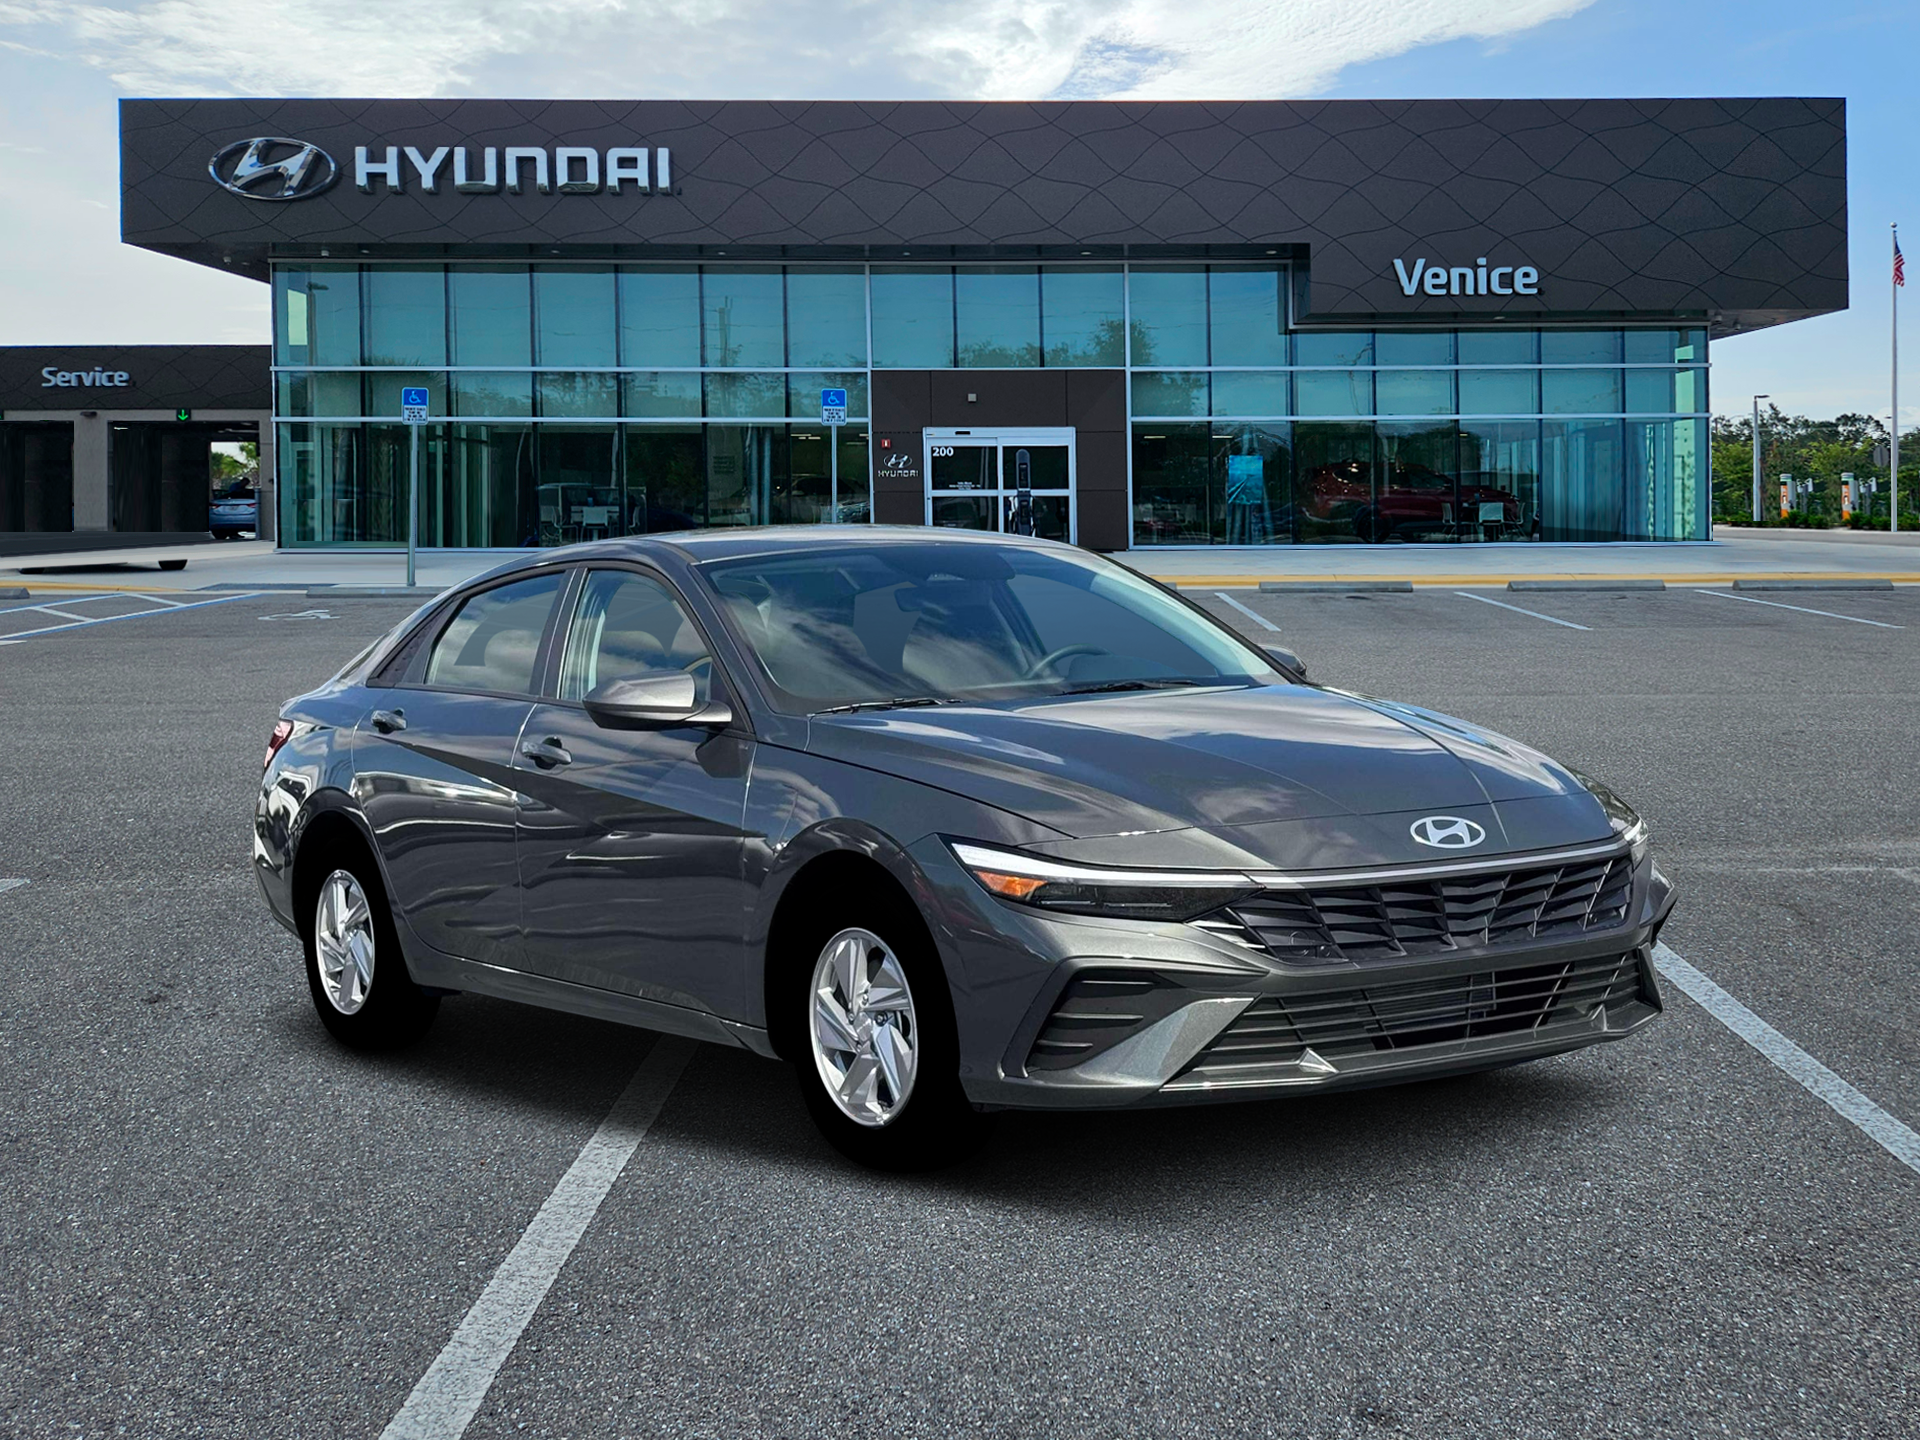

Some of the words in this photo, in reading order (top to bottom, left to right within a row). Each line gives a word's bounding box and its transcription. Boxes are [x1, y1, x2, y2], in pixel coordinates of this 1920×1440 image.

[354, 145, 672, 194] HYUNDAI
[1393, 257, 1539, 296] Venice
[41, 366, 130, 387] Service
[932, 446, 954, 457] 200
[877, 469, 919, 478] HYUNDAI
